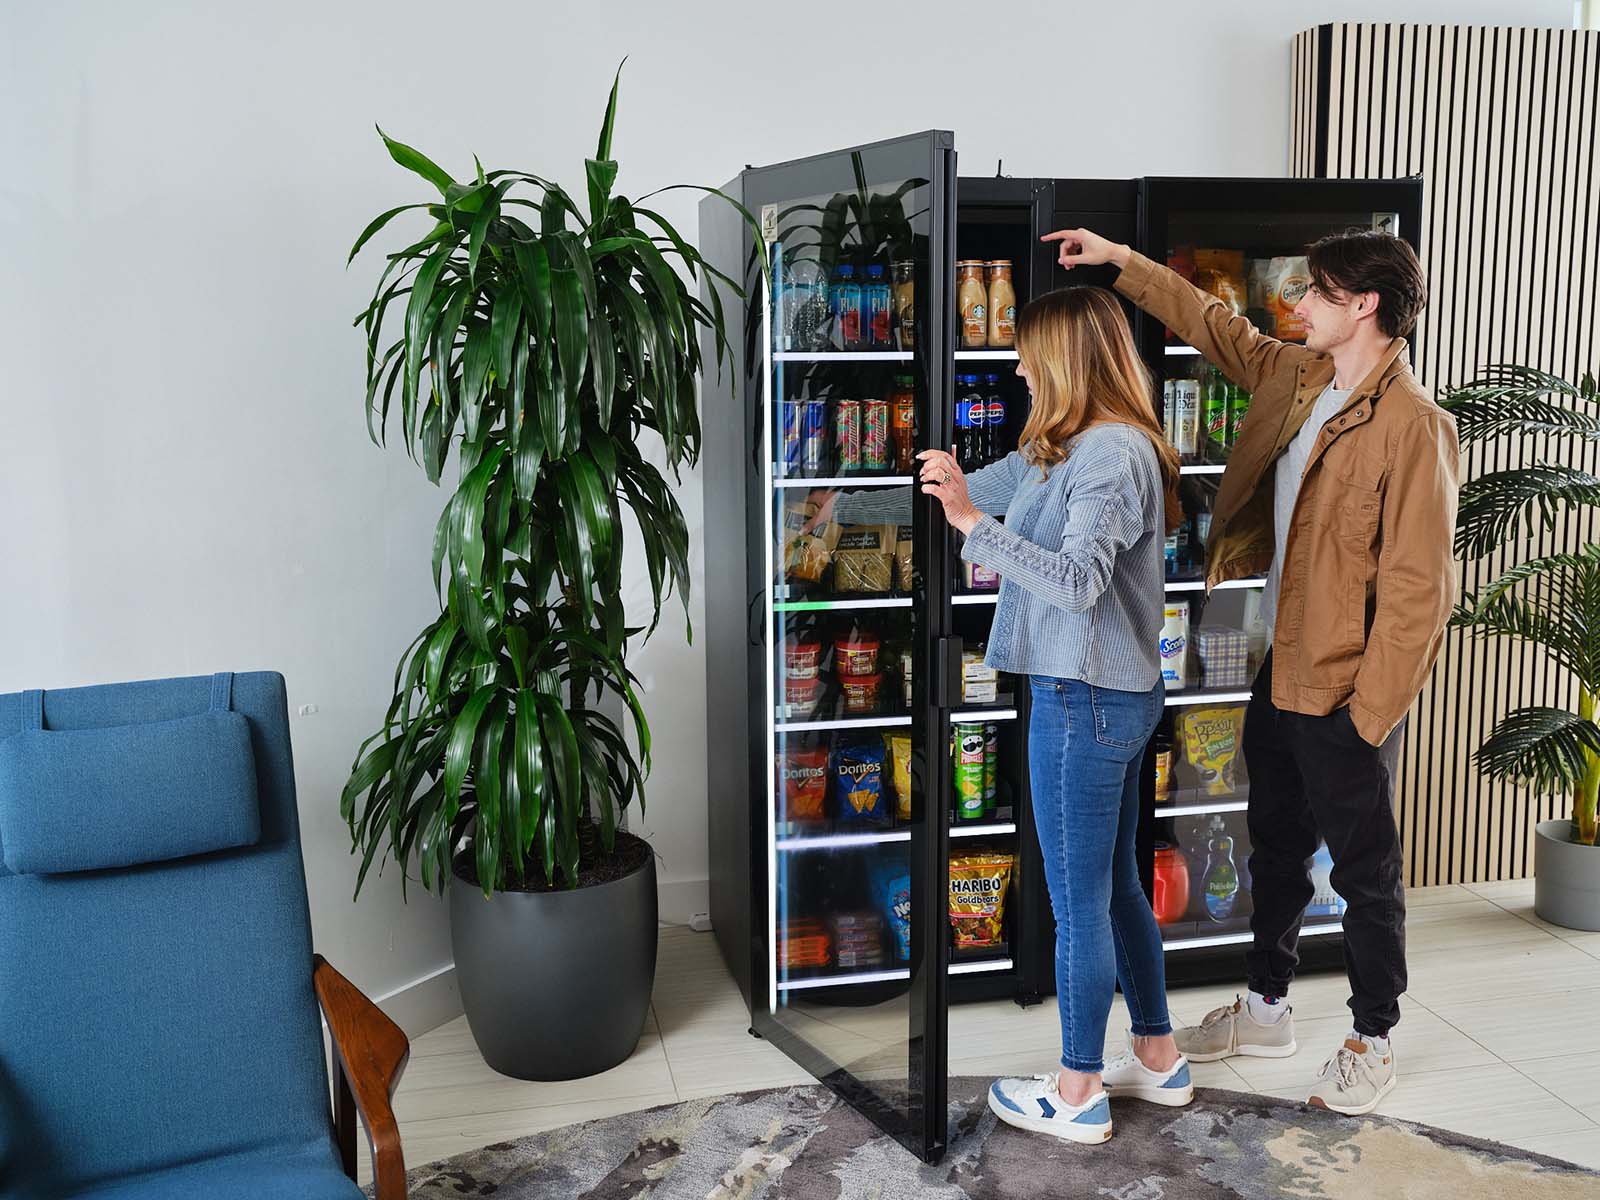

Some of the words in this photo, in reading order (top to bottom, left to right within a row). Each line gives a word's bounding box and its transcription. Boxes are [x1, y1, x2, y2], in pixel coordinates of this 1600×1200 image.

[784, 767, 824, 779] Doritos
[839, 763, 881, 775] Doritos
[951, 878, 1002, 893] HARIBO
